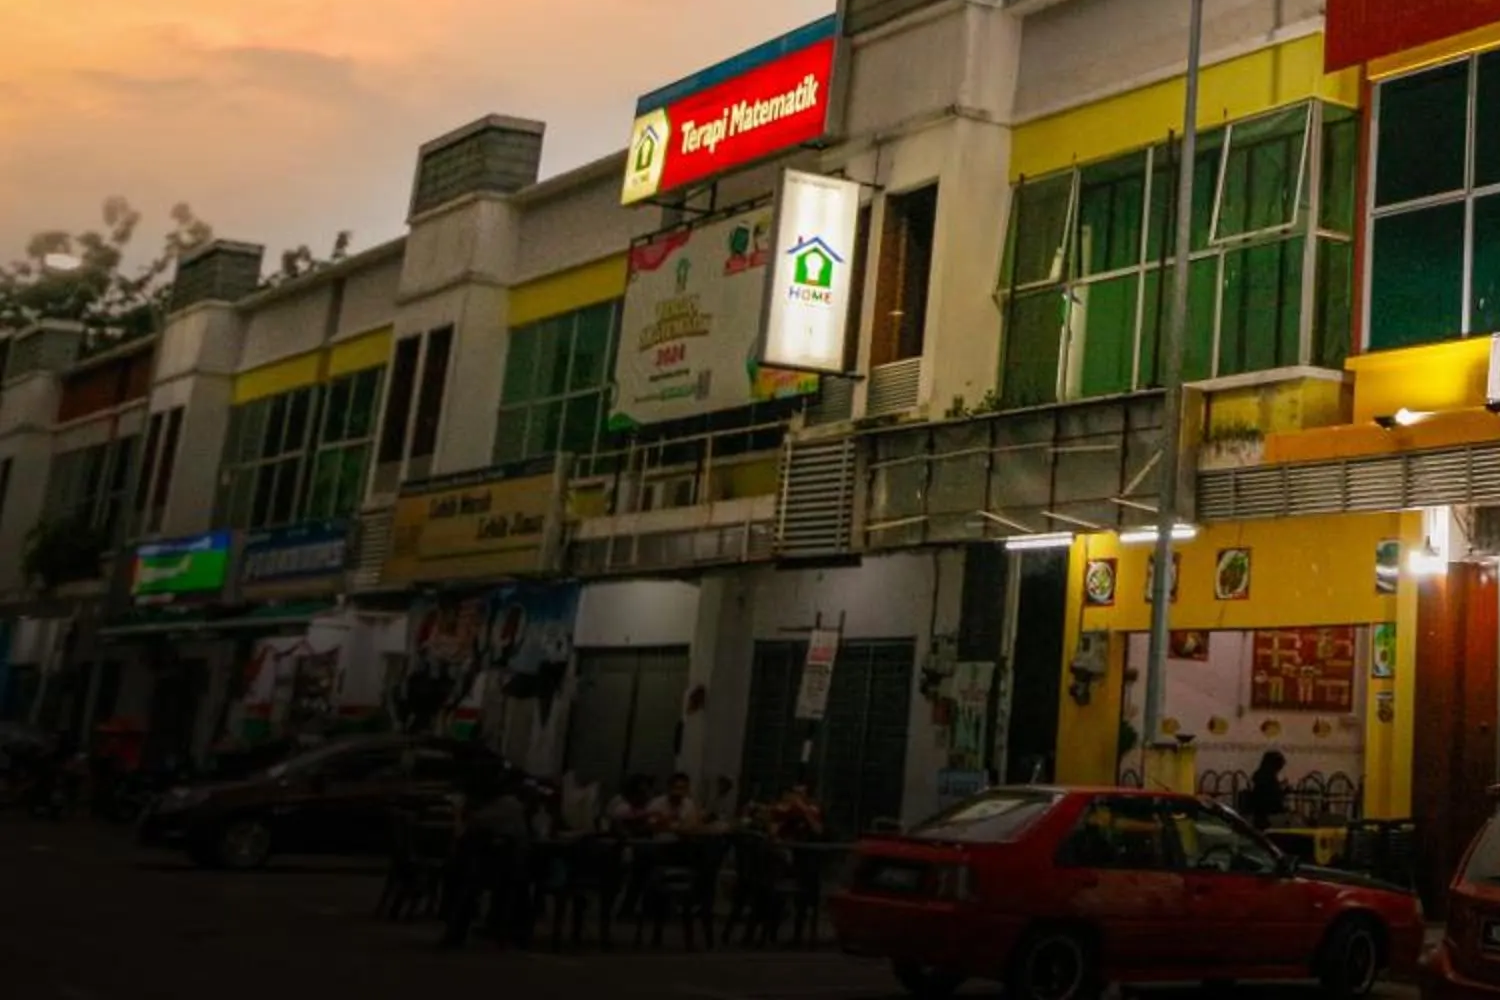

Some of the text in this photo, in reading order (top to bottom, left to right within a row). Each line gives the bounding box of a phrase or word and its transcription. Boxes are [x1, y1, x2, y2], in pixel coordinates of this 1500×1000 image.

[681, 72, 820, 155] Terapi Matematik
[788, 286, 833, 305] HOME
